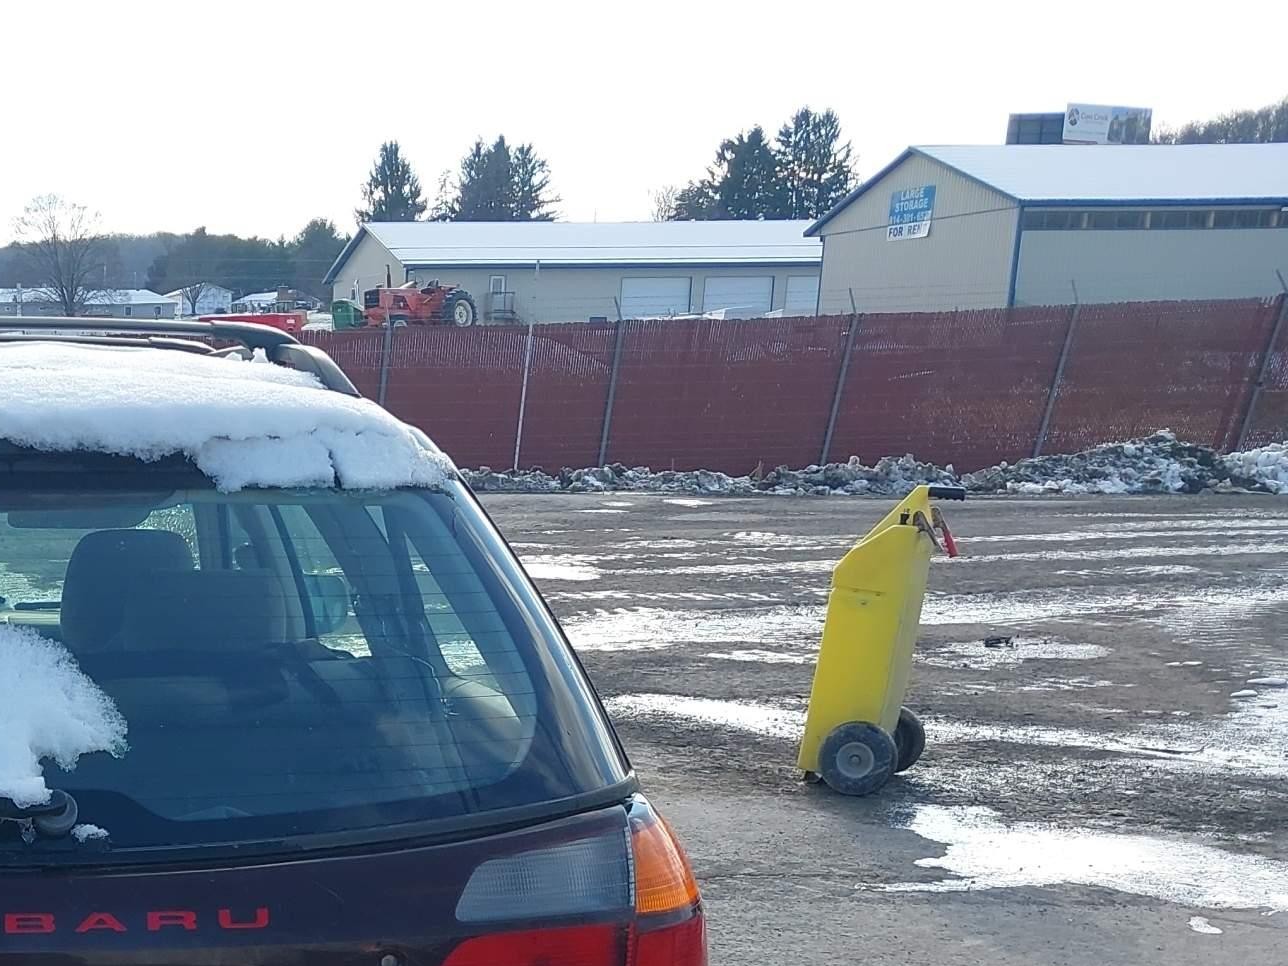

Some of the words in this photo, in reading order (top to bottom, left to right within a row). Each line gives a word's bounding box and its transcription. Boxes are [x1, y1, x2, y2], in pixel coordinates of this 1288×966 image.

[901, 187, 925, 200] LARGE
[895, 198, 929, 213] STORAGE
[888, 226, 904, 238] FOR
